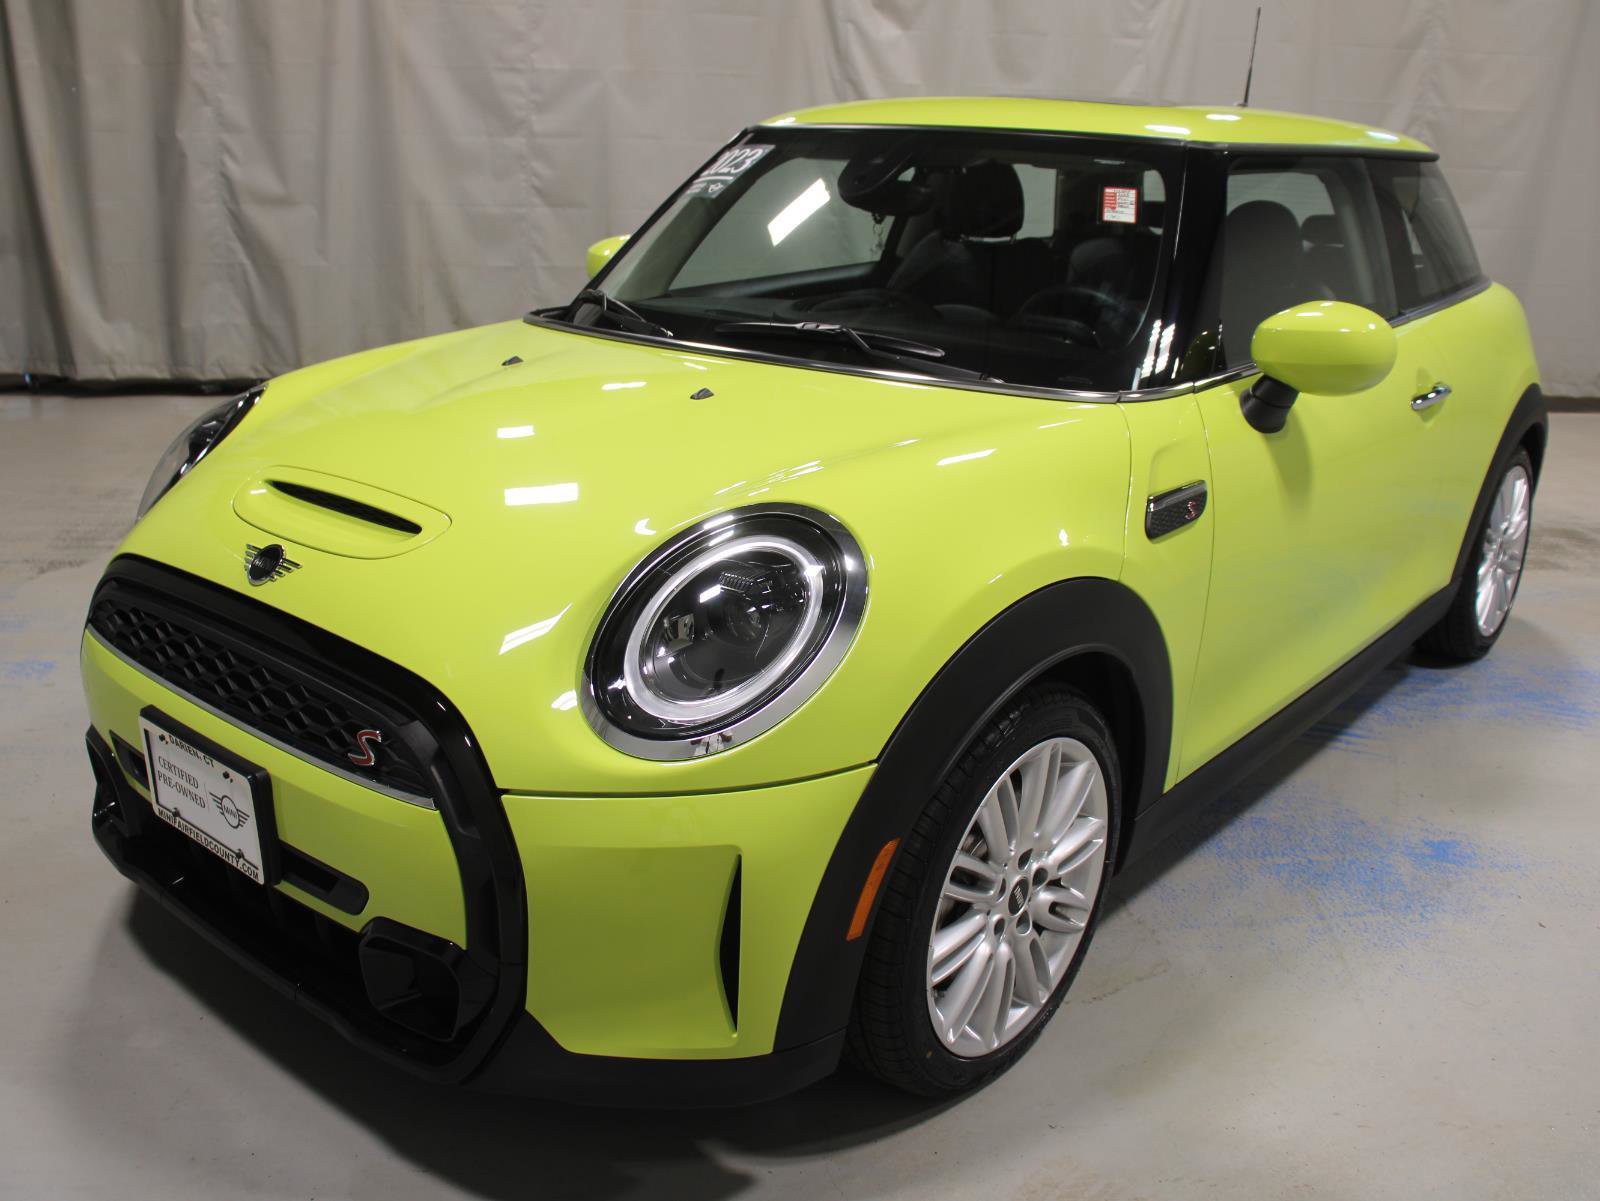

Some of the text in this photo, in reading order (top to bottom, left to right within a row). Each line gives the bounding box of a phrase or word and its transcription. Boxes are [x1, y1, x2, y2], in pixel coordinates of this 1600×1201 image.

[203, 754, 215, 768] CT
[347, 729, 382, 766] S
[157, 770, 206, 809] PRE-OWNED
[158, 755, 199, 789] CERTIFIED
[223, 804, 238, 819] MINI
[157, 807, 259, 881] MINIFAIRFIELDCOUNTY.COM
